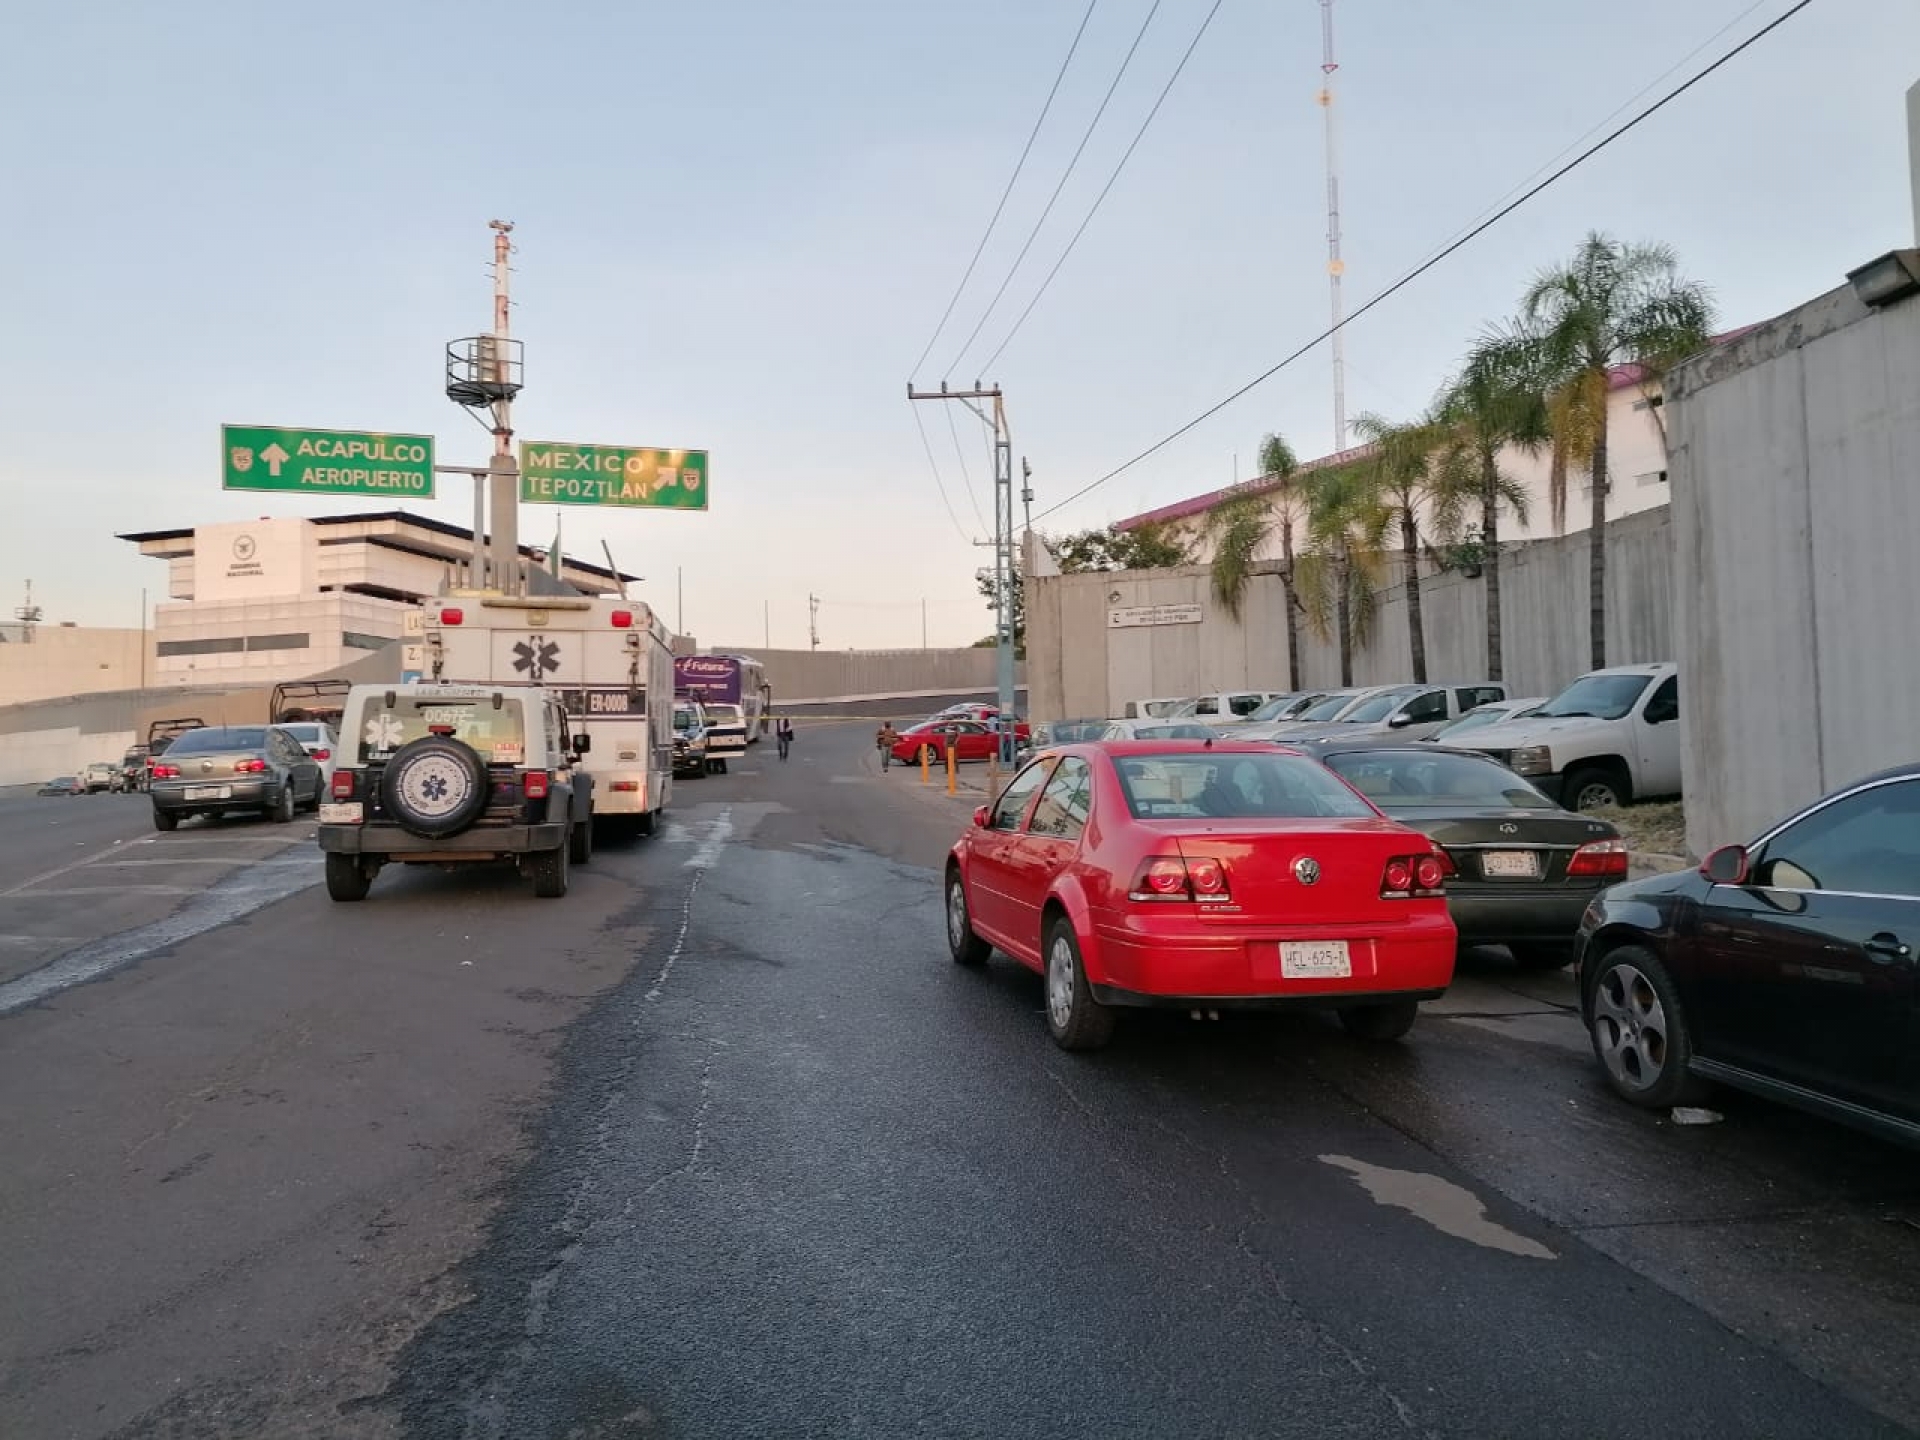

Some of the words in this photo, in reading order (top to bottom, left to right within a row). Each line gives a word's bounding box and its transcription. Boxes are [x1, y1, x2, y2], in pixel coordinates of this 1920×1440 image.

[297, 438, 426, 463] ACAPULCO
[529, 450, 644, 474] MEXICO
[302, 467, 425, 490] AEROPUERTO
[527, 476, 648, 499] TEPOZTLAN
